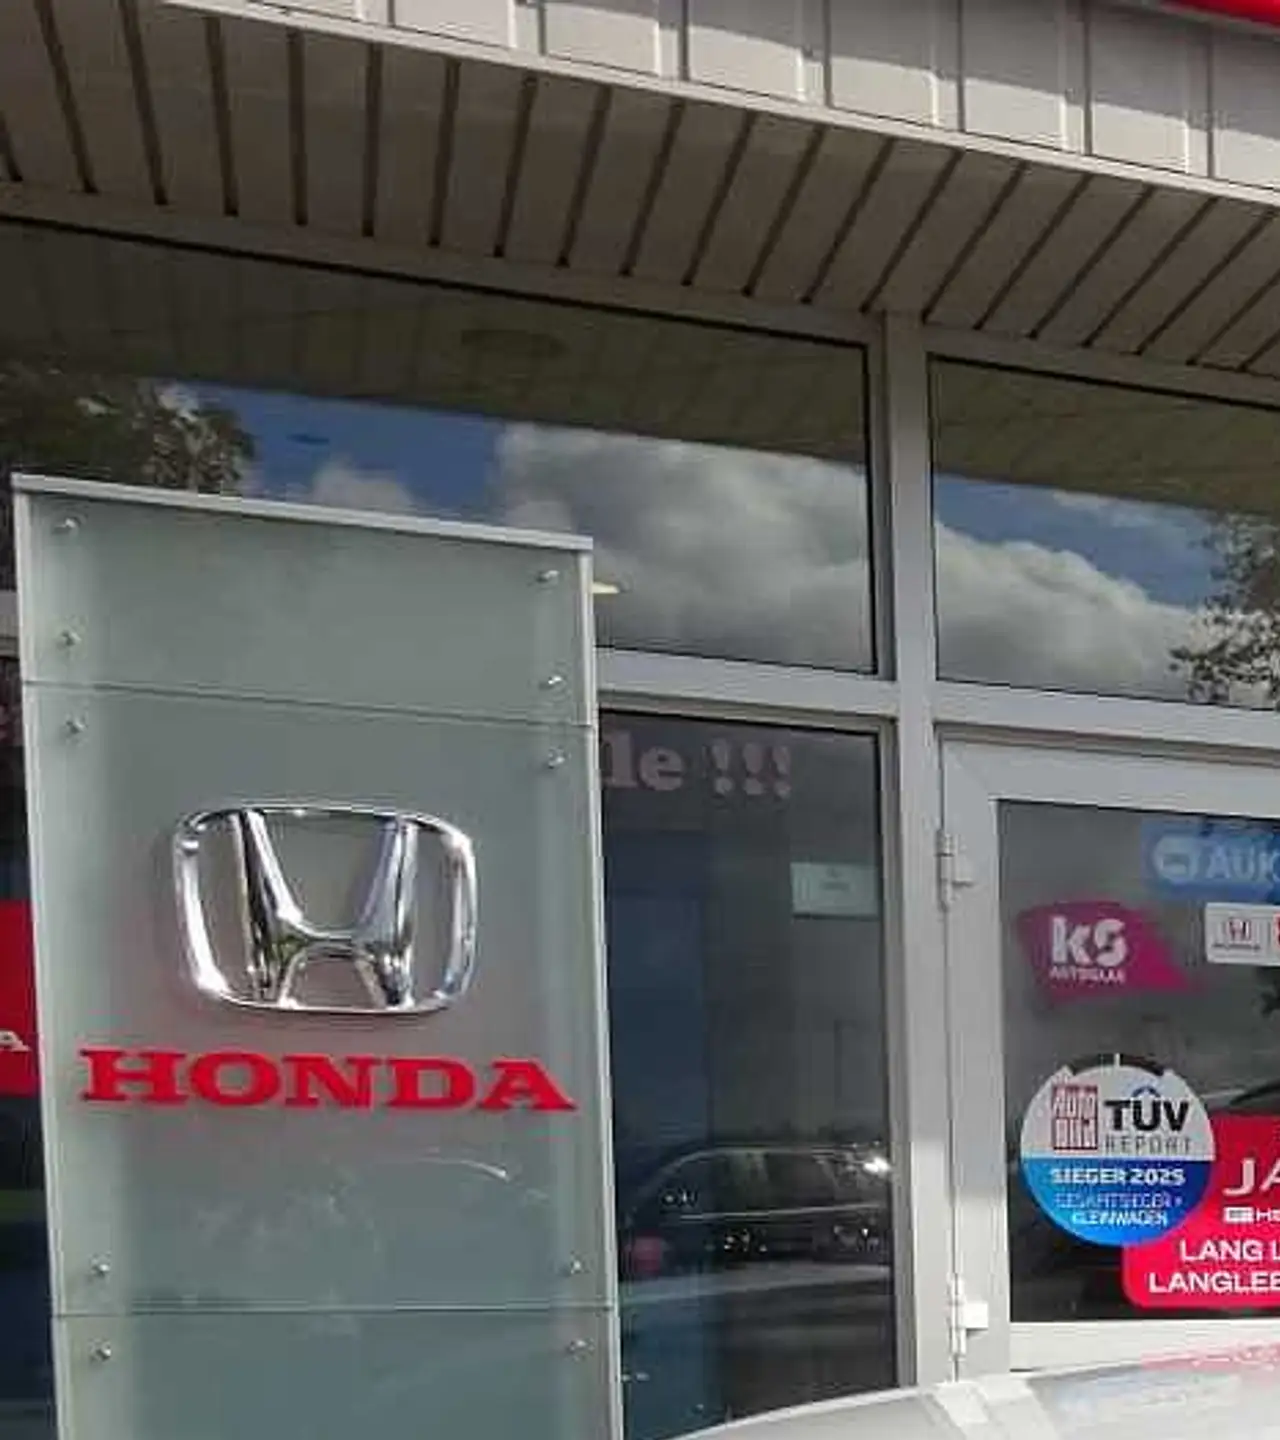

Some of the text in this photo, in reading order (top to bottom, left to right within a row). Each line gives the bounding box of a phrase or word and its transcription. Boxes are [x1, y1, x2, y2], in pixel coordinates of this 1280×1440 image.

[80, 1048, 576, 1112] HONDA
[1104, 1085, 1190, 1132] TÜV
[1050, 1167, 1185, 1186] SIEGER 2025
[1179, 1240, 1264, 1263] LANG
